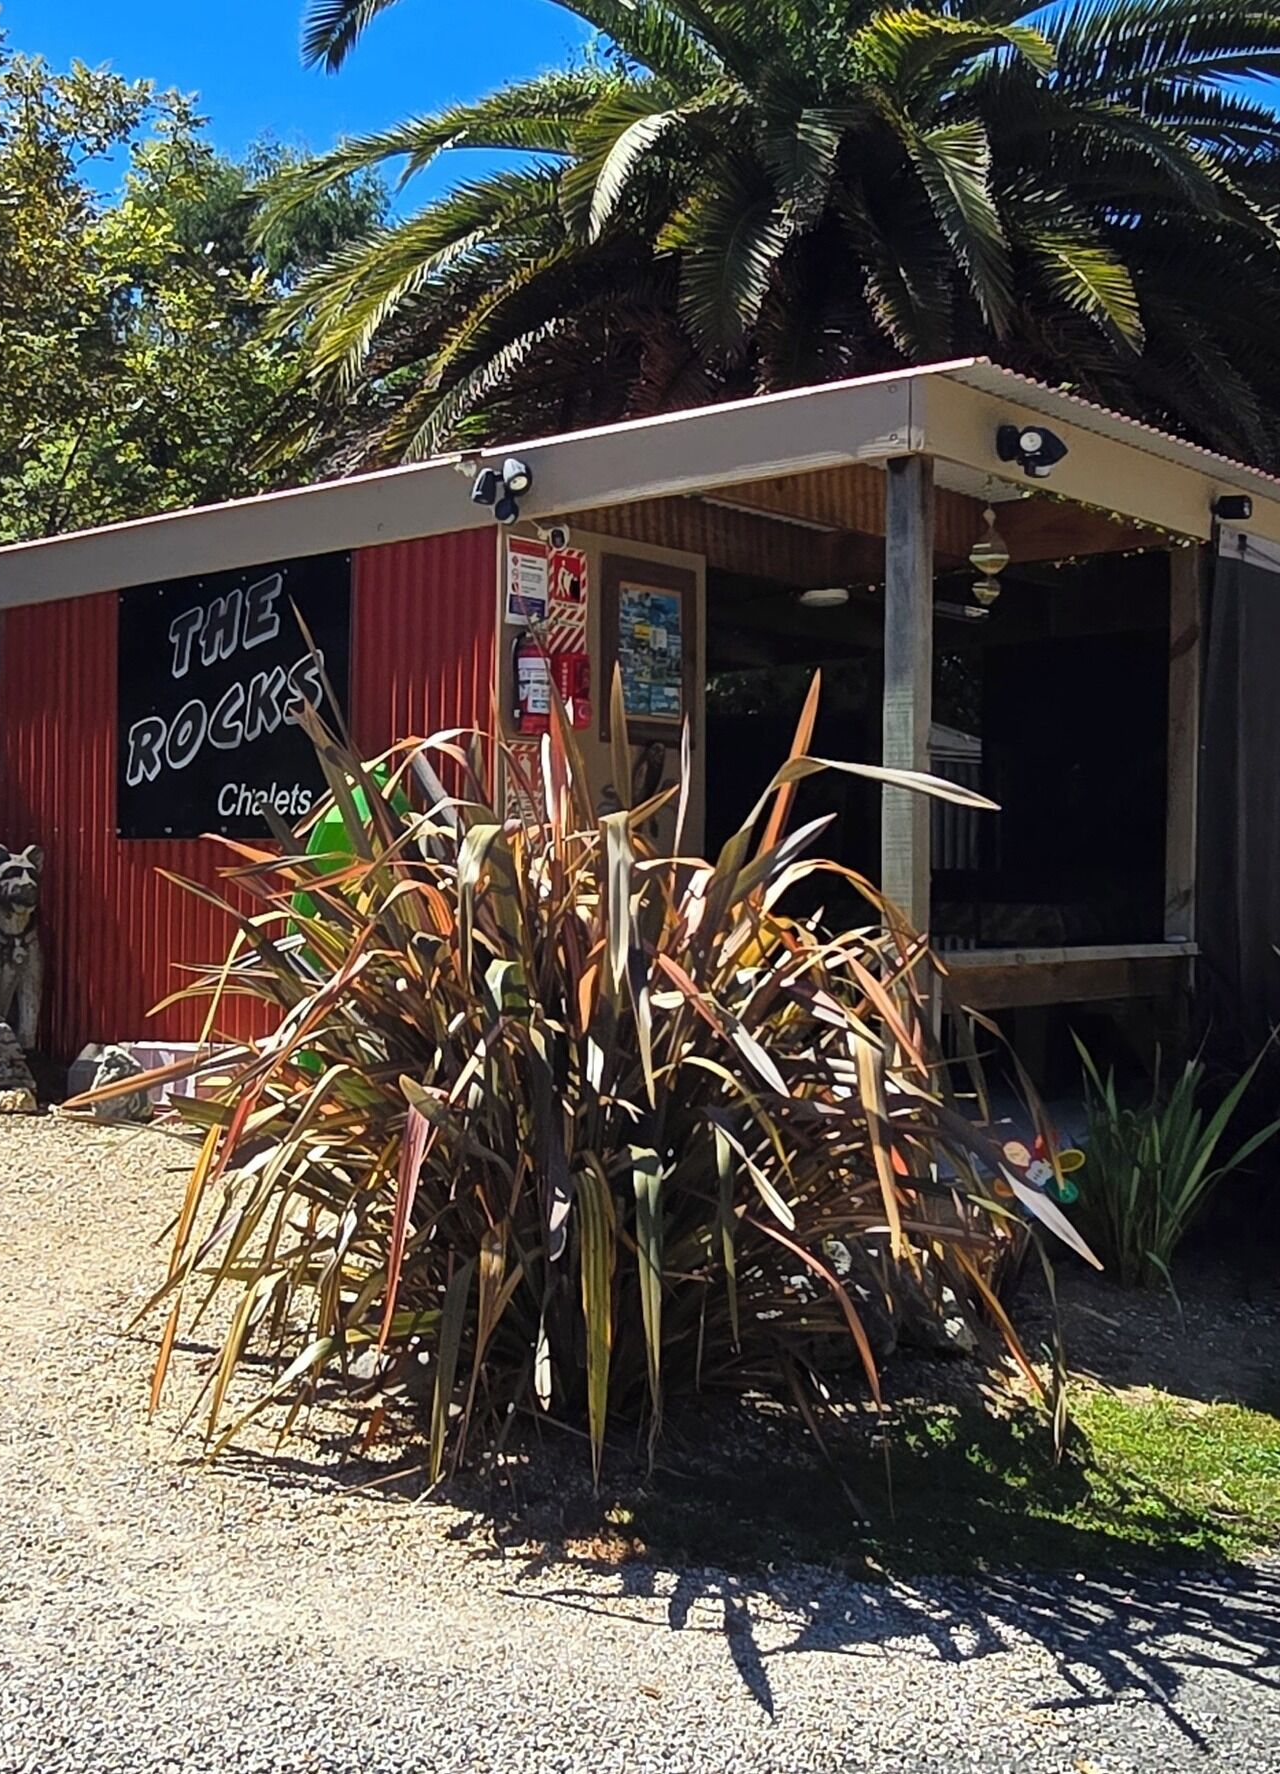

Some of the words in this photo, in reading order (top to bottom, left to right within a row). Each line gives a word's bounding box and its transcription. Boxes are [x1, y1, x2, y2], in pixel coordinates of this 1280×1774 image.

[168, 572, 283, 679] THE
[126, 648, 325, 787] ROCKS
[217, 782, 313, 817] Chalets
